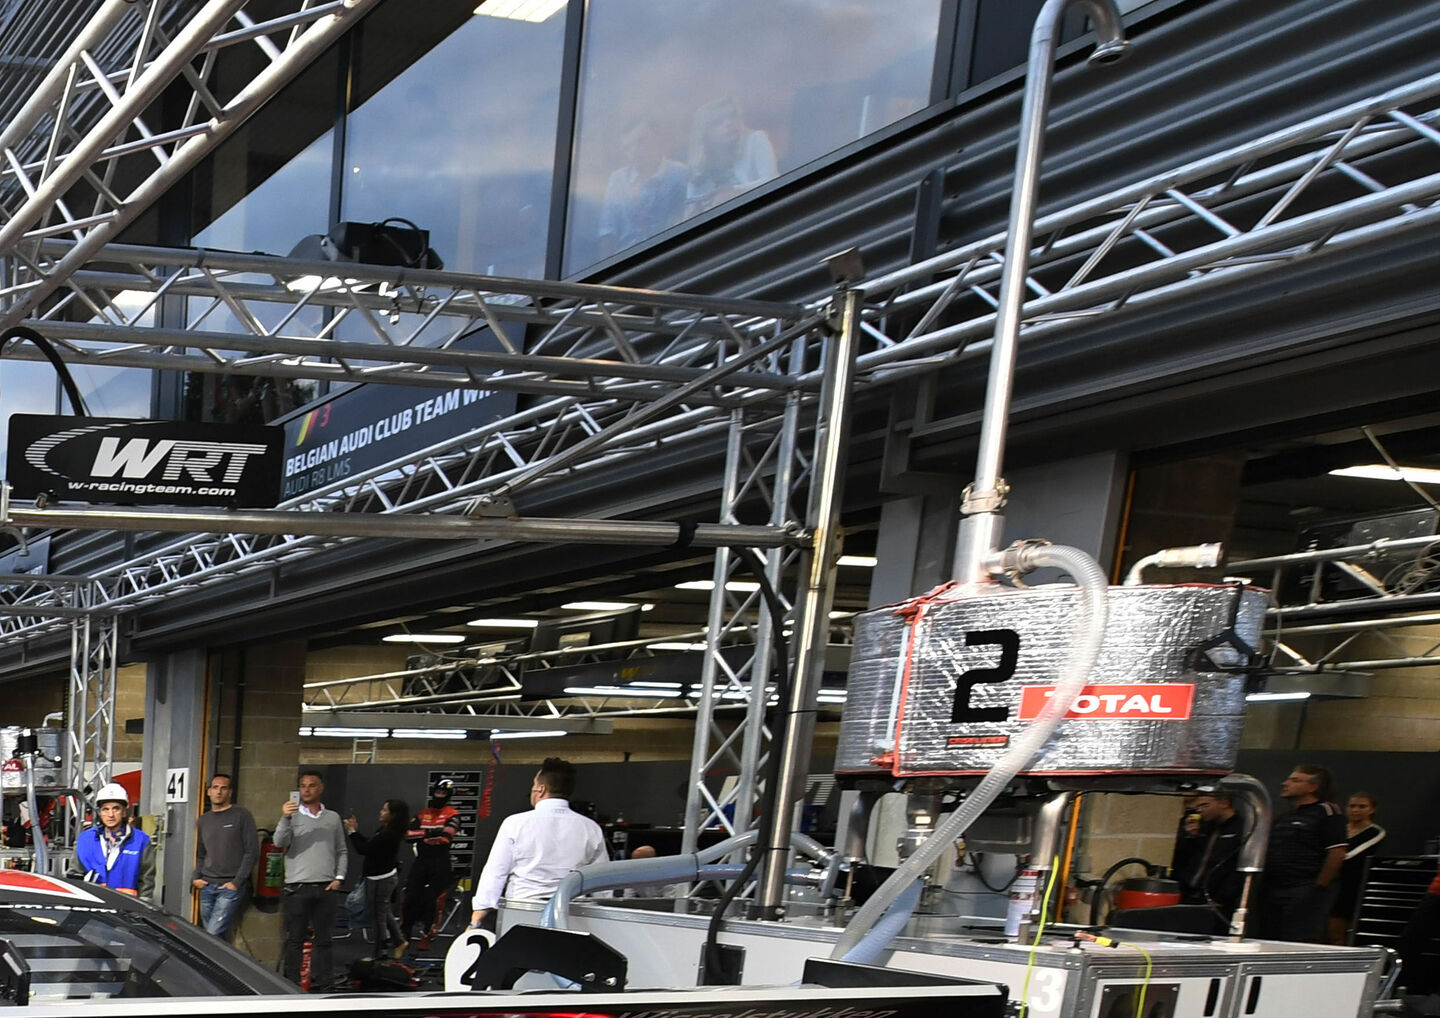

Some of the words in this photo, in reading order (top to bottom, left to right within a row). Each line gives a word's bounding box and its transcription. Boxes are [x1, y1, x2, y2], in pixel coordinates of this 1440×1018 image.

[285, 439, 340, 478] BELGIAN
[340, 424, 373, 454] AUDI
[374, 408, 413, 441] CLUB
[415, 388, 461, 425] TEAM
[90, 436, 268, 484] WRT
[284, 476, 310, 498] AUDI
[310, 470, 326, 488] R8
[327, 457, 352, 482] LMS
[68, 480, 237, 498] w-racingteam.com
[951, 627, 1020, 723] 2
[1044, 690, 1173, 714] OTAL
[167, 772, 185, 799] 41
[1031, 968, 1063, 1013] 3
